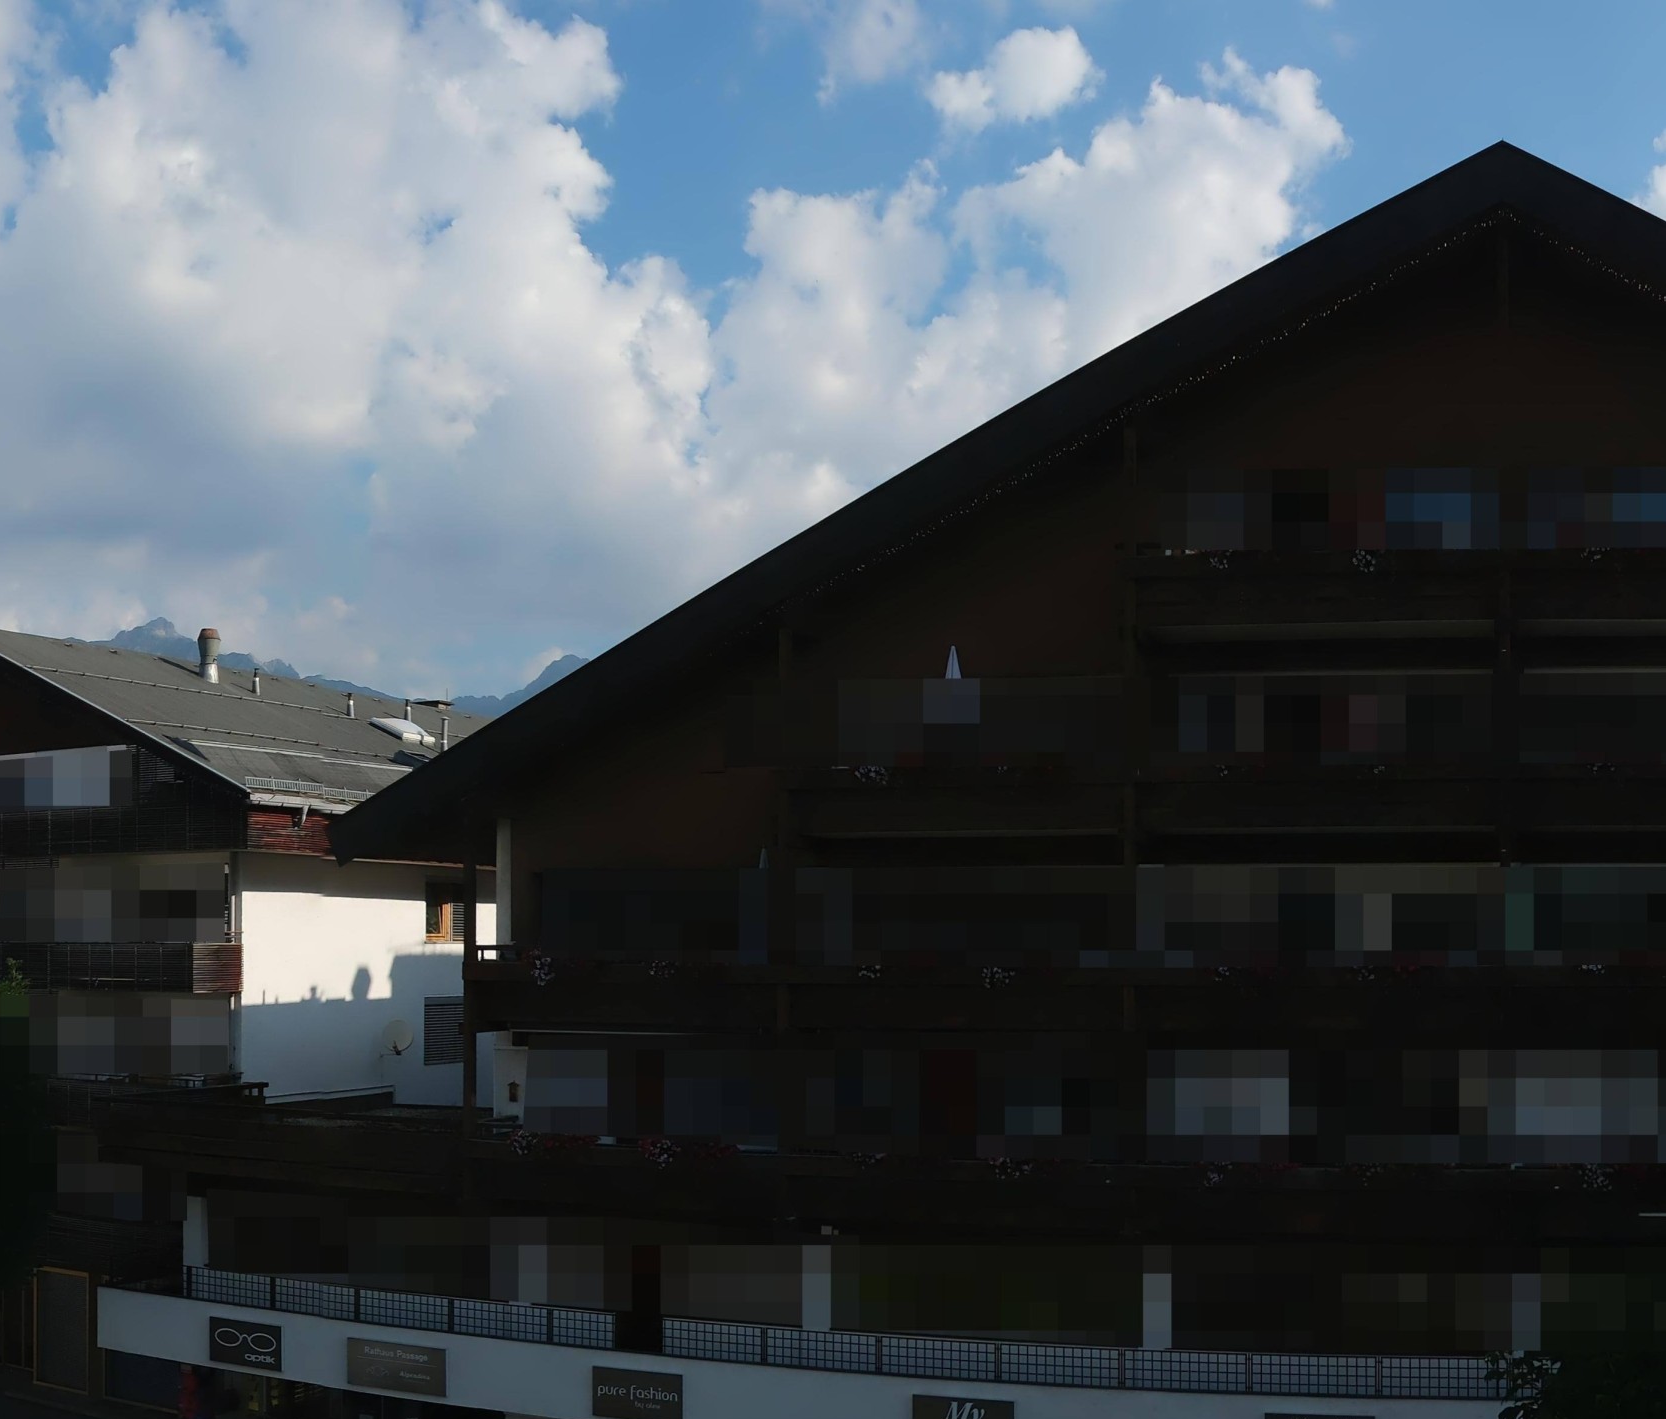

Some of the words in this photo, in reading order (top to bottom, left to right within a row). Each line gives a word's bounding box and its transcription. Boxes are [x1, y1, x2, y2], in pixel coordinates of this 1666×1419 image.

[245, 1353, 276, 1365] optik
[597, 1385, 626, 1397] pure
[630, 1385, 678, 1401] fashion
